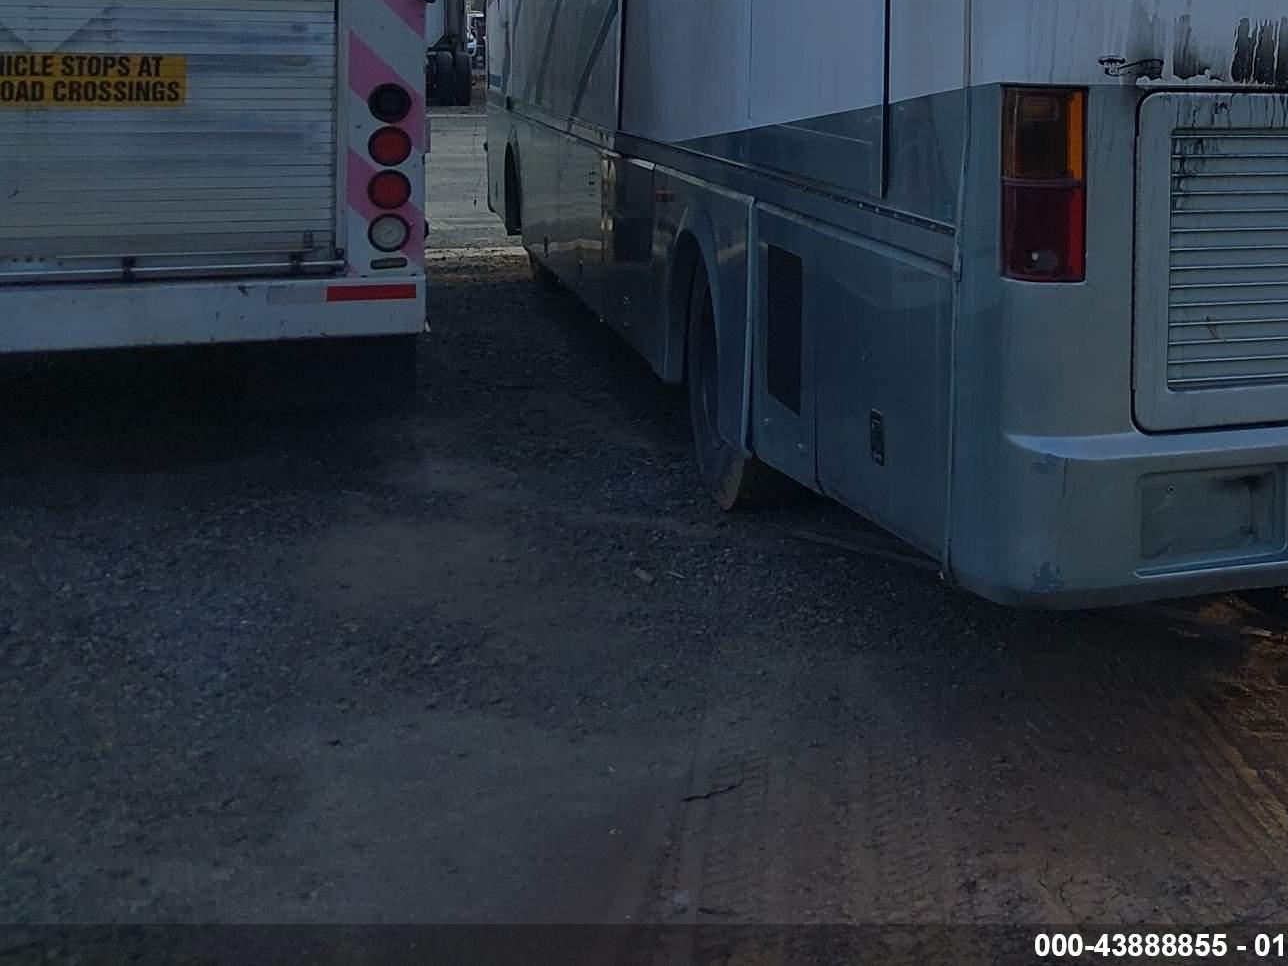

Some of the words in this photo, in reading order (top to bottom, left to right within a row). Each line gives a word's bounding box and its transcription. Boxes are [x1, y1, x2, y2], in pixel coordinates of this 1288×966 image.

[61, 55, 130, 77] STOPS
[138, 56, 163, 77] AT
[52, 81, 180, 102] CROSSINGS
